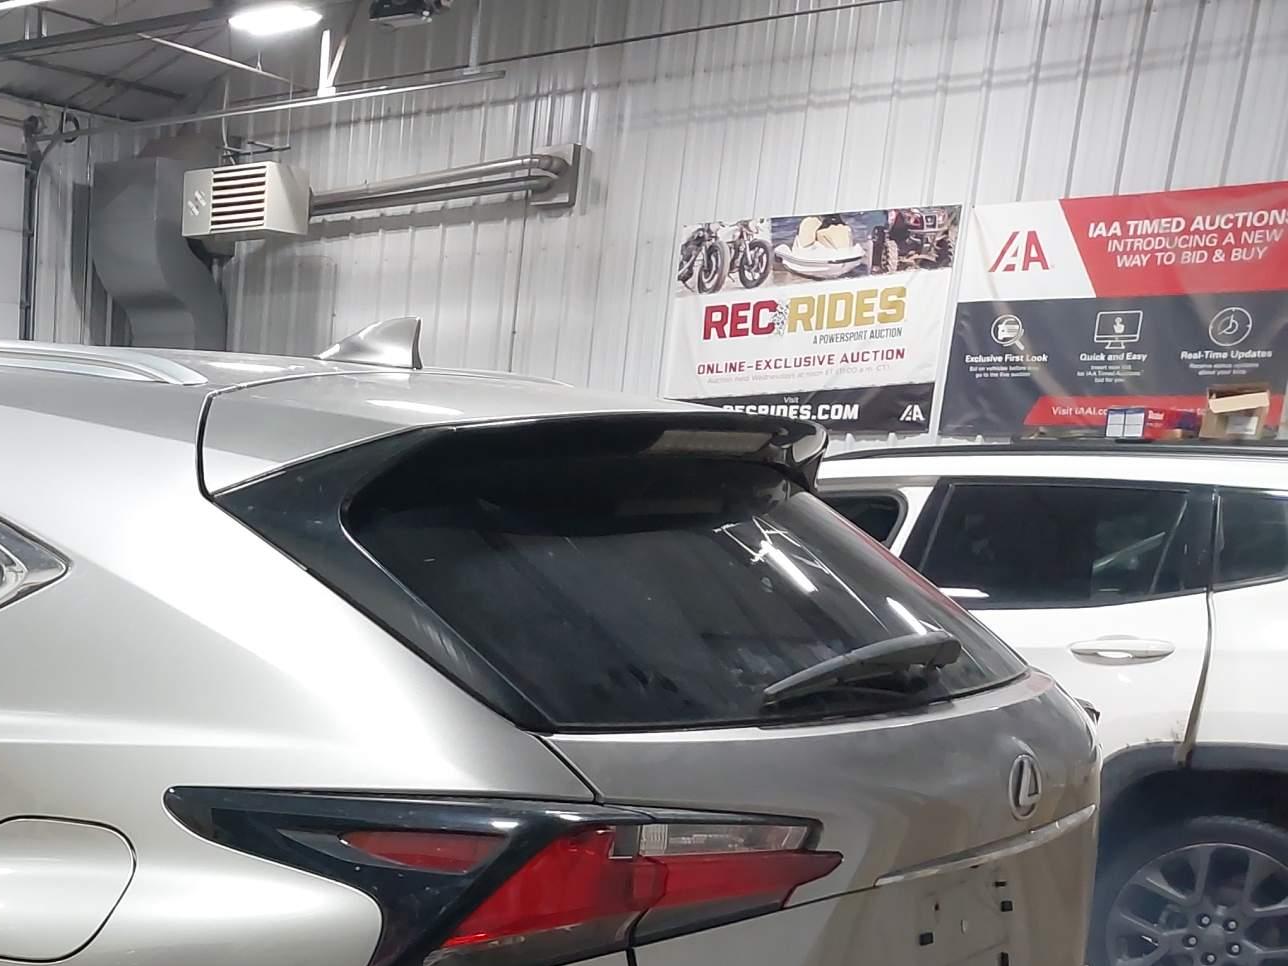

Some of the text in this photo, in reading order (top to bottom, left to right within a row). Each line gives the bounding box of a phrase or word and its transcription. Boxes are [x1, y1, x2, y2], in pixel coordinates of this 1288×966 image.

[1089, 208, 1288, 238] IAA TIMED AUCTION
[1107, 228, 1284, 253] INTRODUCING A NEW
[1116, 246, 1269, 269] WAY TO BID & BUY
[703, 286, 907, 341] REC RIDES
[813, 327, 903, 345] A POWERSPORT AUCTION
[697, 353, 836, 376] ONLINE-EXCLUSIVE
[840, 348, 906, 365] AUCTION
[965, 353, 1049, 363] Exclusive First Look
[1079, 352, 1148, 362] Quick and Easy
[1180, 349, 1273, 360] Real-Time Updates
[1052, 406, 1072, 416] Visit
